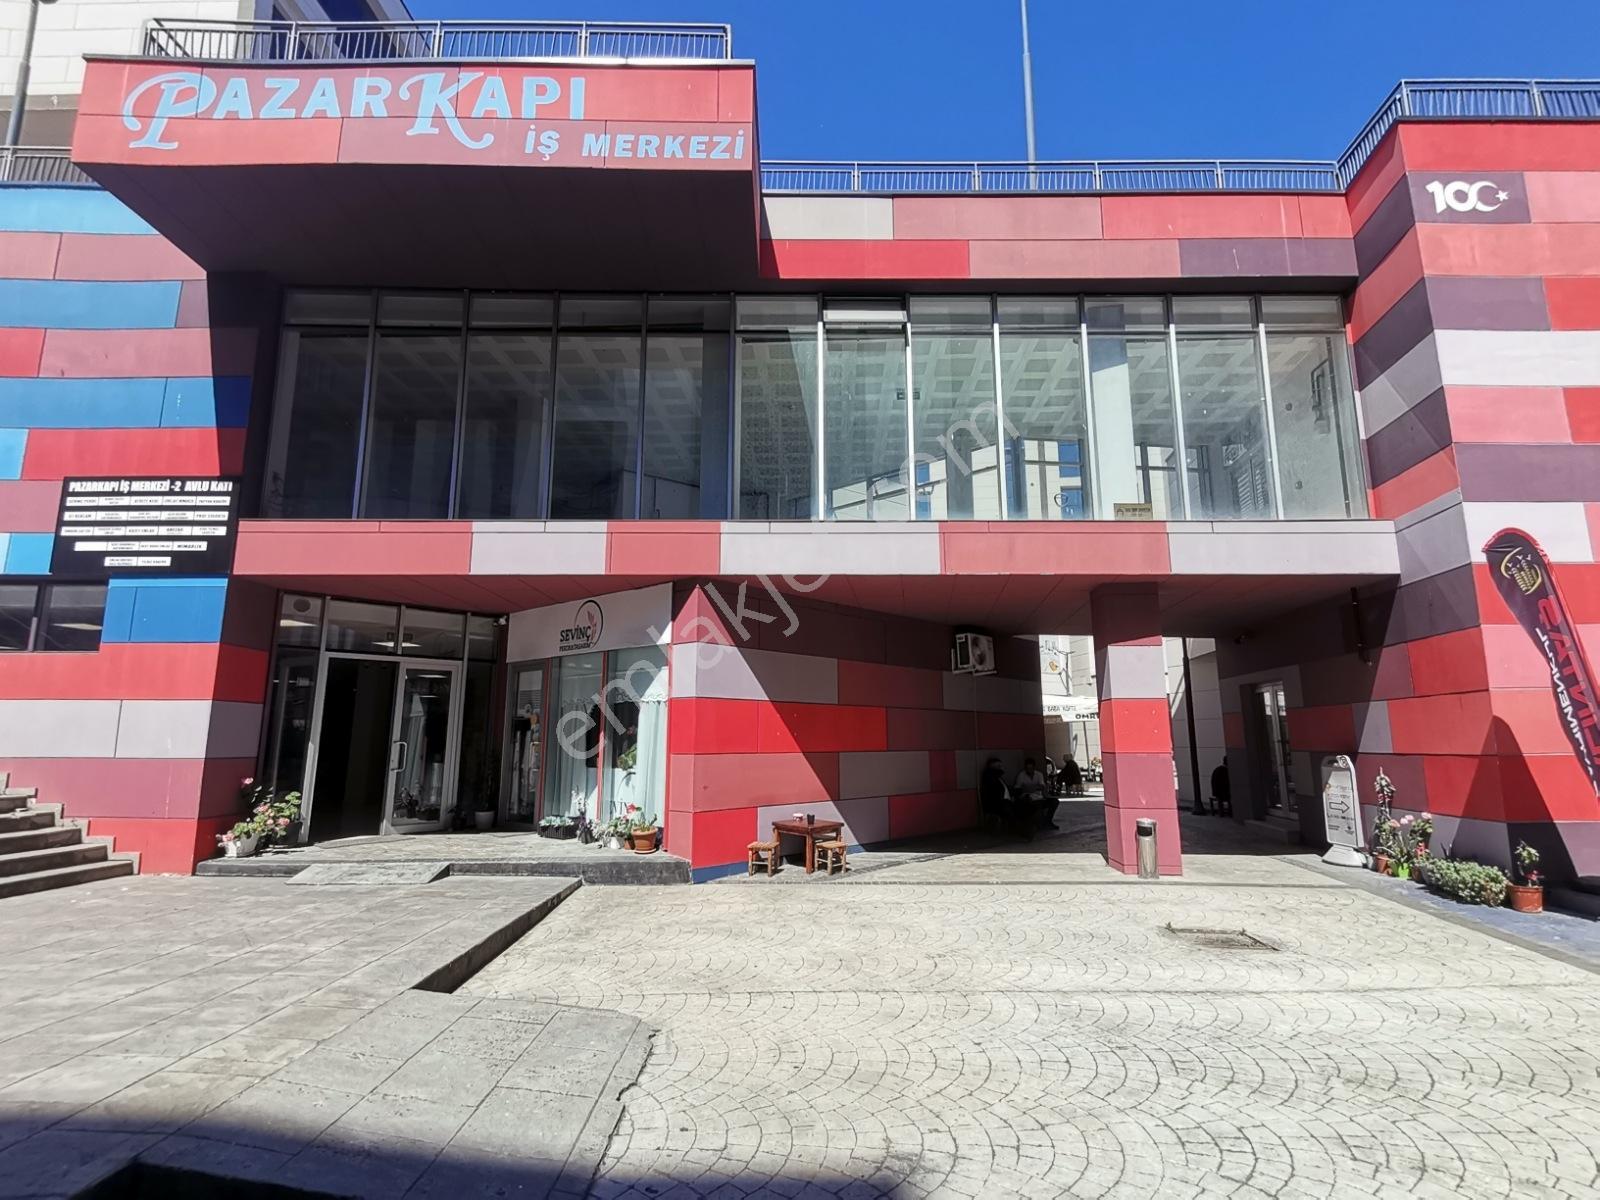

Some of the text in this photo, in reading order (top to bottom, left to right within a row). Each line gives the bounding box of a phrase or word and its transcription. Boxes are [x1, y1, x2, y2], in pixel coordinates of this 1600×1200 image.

[525, 128, 745, 161] İŞ MERKEZİ
[68, 481, 119, 492] PAZARKAPI
[119, 479, 131, 494] İŞ
[130, 479, 171, 492] MERKEZİ
[184, 481, 209, 492] AVLU
[210, 481, 233, 492] KATI
[560, 625, 592, 642] SEVİNÇ
